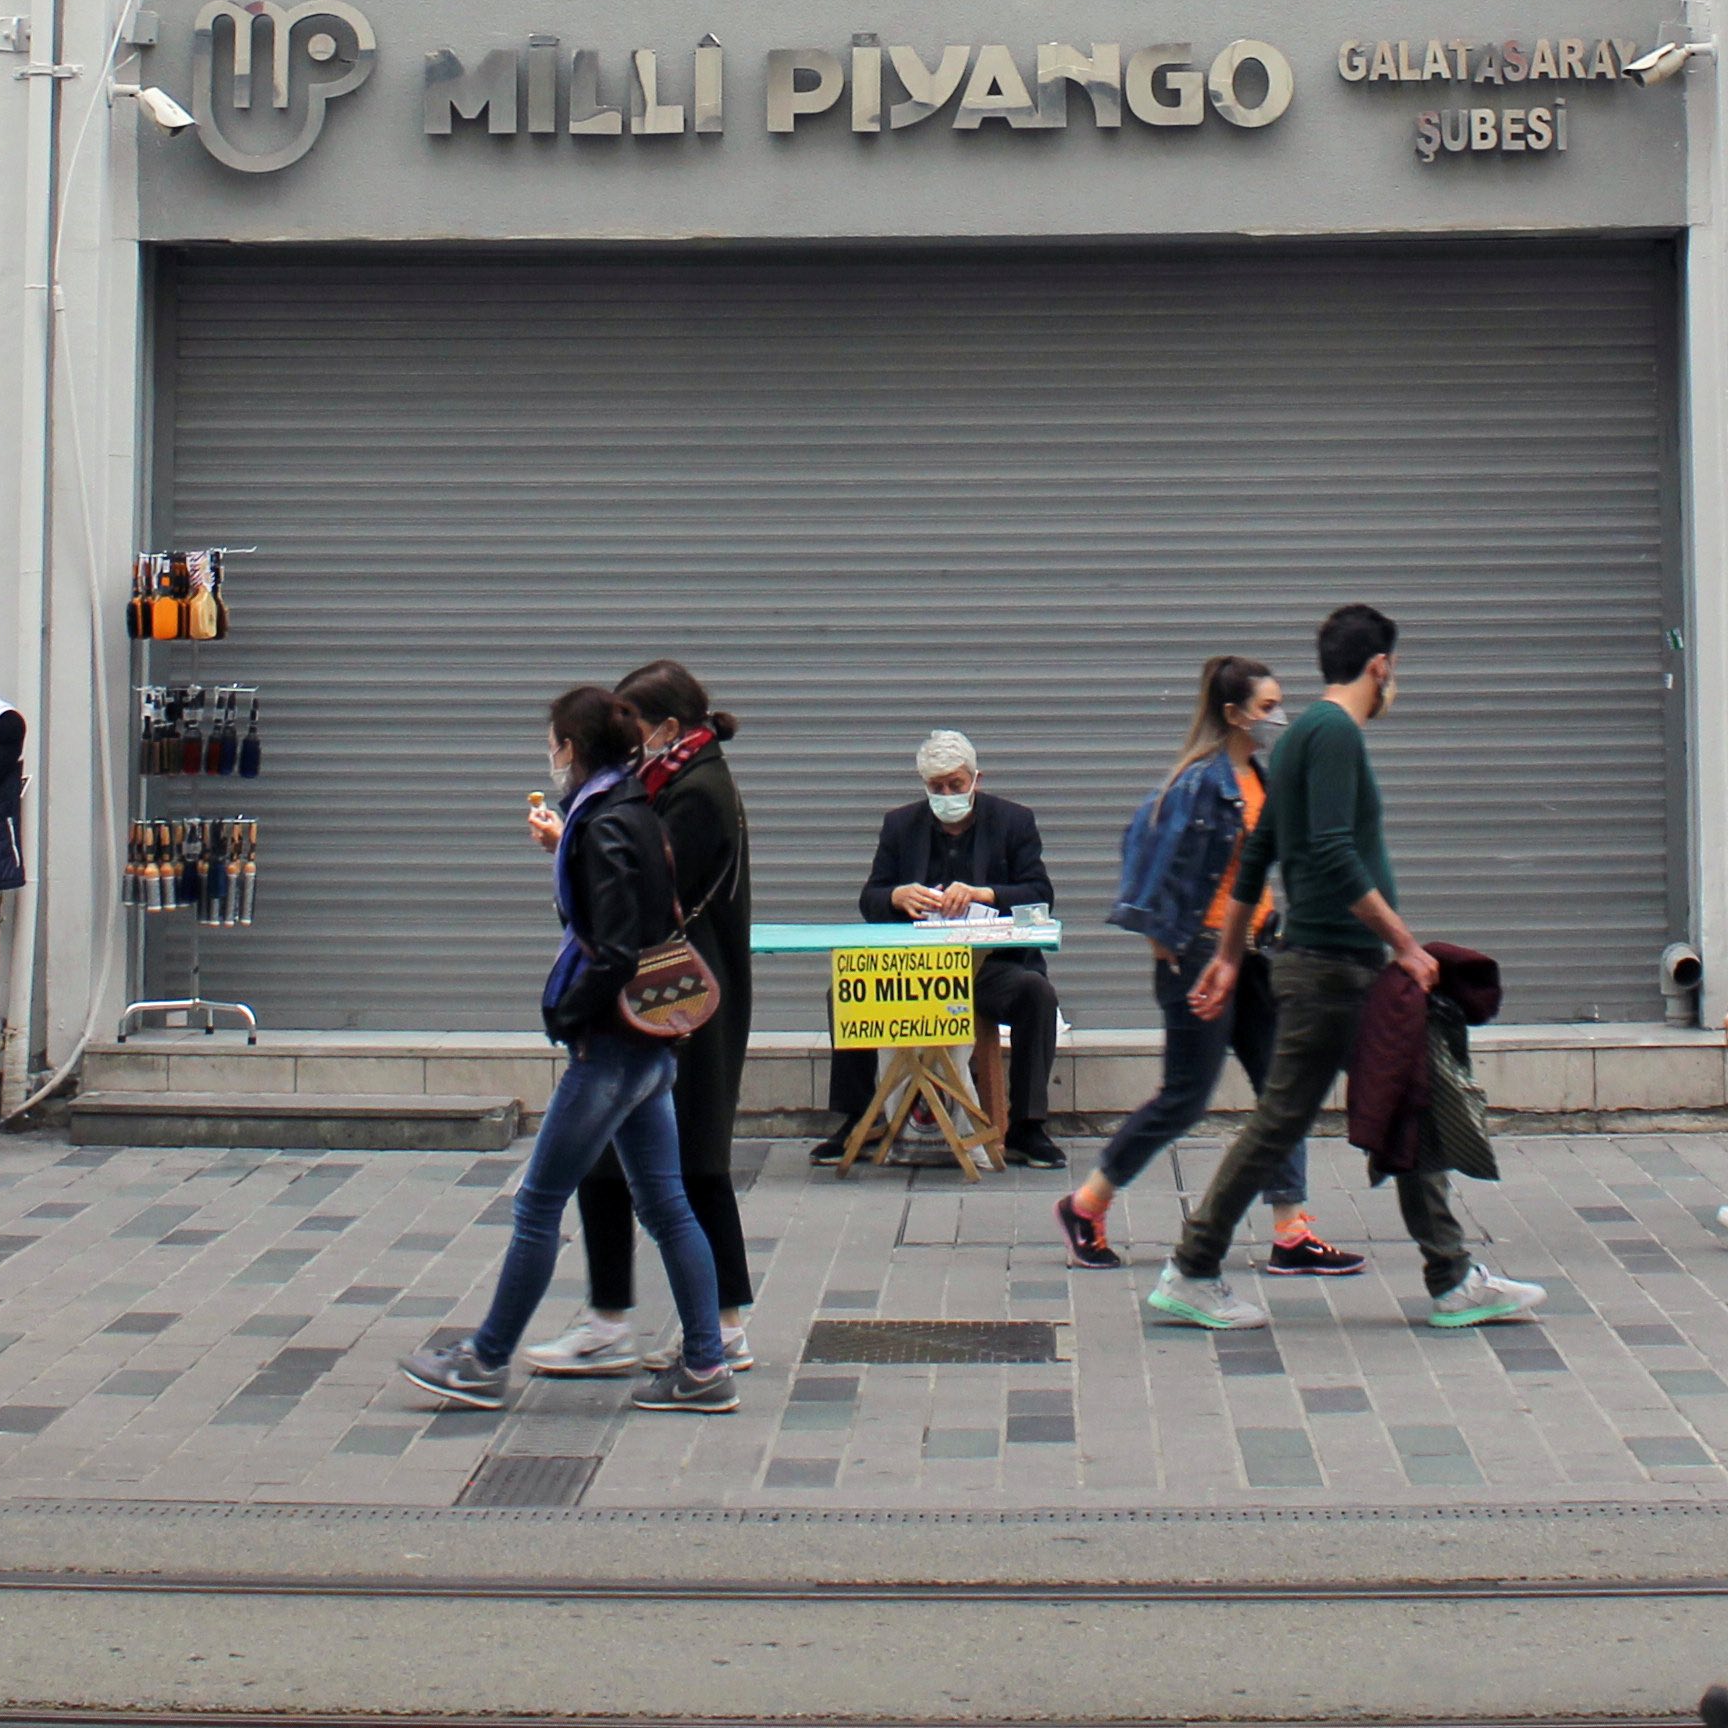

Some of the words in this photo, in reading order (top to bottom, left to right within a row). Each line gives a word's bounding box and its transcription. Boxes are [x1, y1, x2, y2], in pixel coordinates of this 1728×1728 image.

[424, 32, 725, 135] MİLLİ
[766, 32, 1295, 133] PİYANGO
[1416, 97, 1568, 163] ŞUBESİ
[837, 953, 878, 977] ÇILGIN
[881, 953, 933, 971] SAYISAL
[937, 951, 970, 970] LOTO
[838, 978, 867, 1003] 80
[875, 972, 970, 1002] MİLYON
[840, 1020, 884, 1038] YARIN
[889, 1015, 970, 1041] ÇEKİLİYOR
